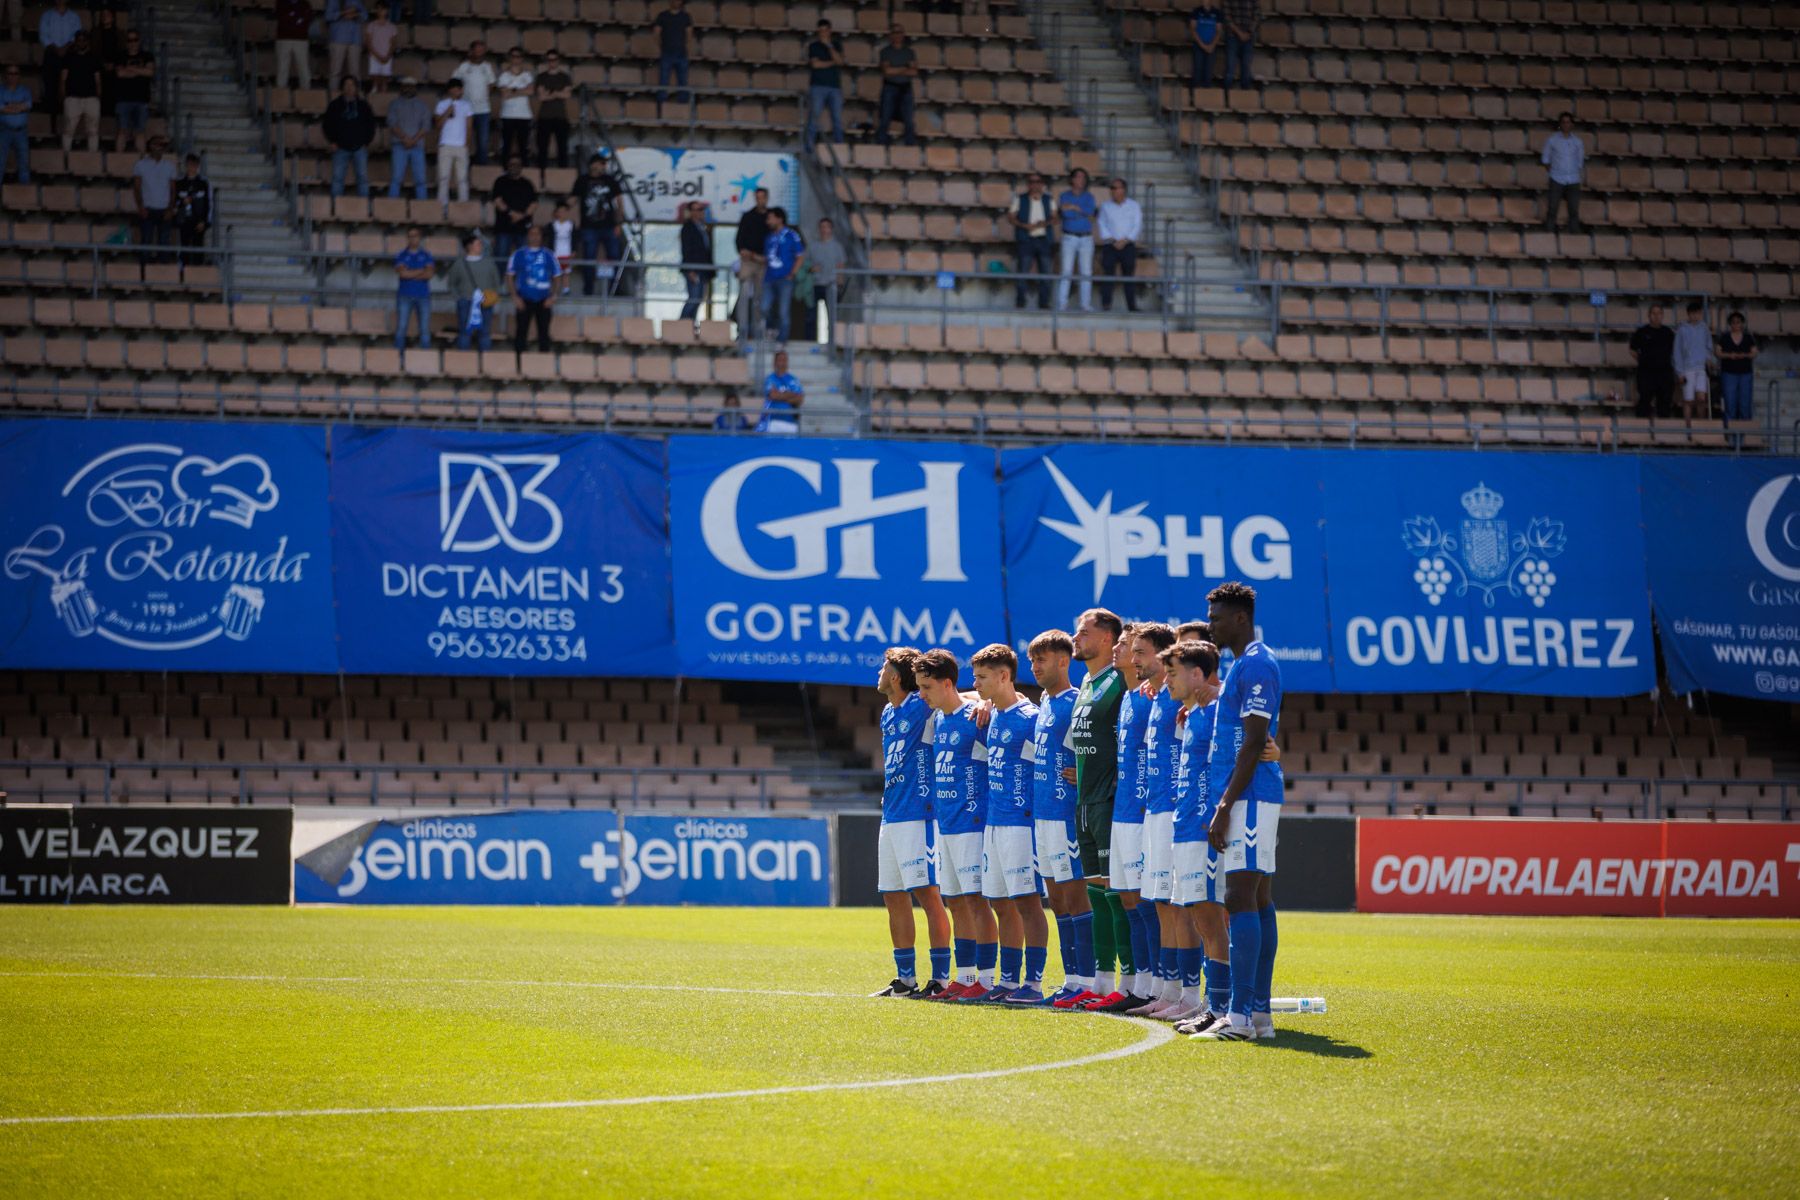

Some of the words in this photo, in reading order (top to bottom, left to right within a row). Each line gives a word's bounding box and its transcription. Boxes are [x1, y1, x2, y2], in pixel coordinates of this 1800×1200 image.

[86, 463, 212, 527] Bar
[700, 456, 969, 582] GH
[4, 524, 97, 583] La
[105, 530, 310, 583] Rotonda
[1107, 514, 1293, 580] PHG
[382, 562, 590, 601] DICTAMEN
[599, 564, 625, 603] 3
[143, 602, 176, 617] 1998
[438, 606, 577, 631] ASESORES
[705, 602, 975, 645] GOFRAMA
[427, 632, 588, 662] 956326334
[1346, 615, 1638, 668] COVIJEREZ
[1740, 625, 1756, 640] TU
[707, 652, 801, 665] VIVIENDAS
[806, 653, 851, 665] PARA
[1712, 645, 1800, 666] WWW.GA
[916, 749, 926, 783] FoxField
[965, 765, 975, 800] FoxField
[1136, 749, 1146, 785] FoxField
[17, 827, 259, 859] VELAZQUEZ
[1371, 855, 1779, 897] COMPRALAENTRADA
